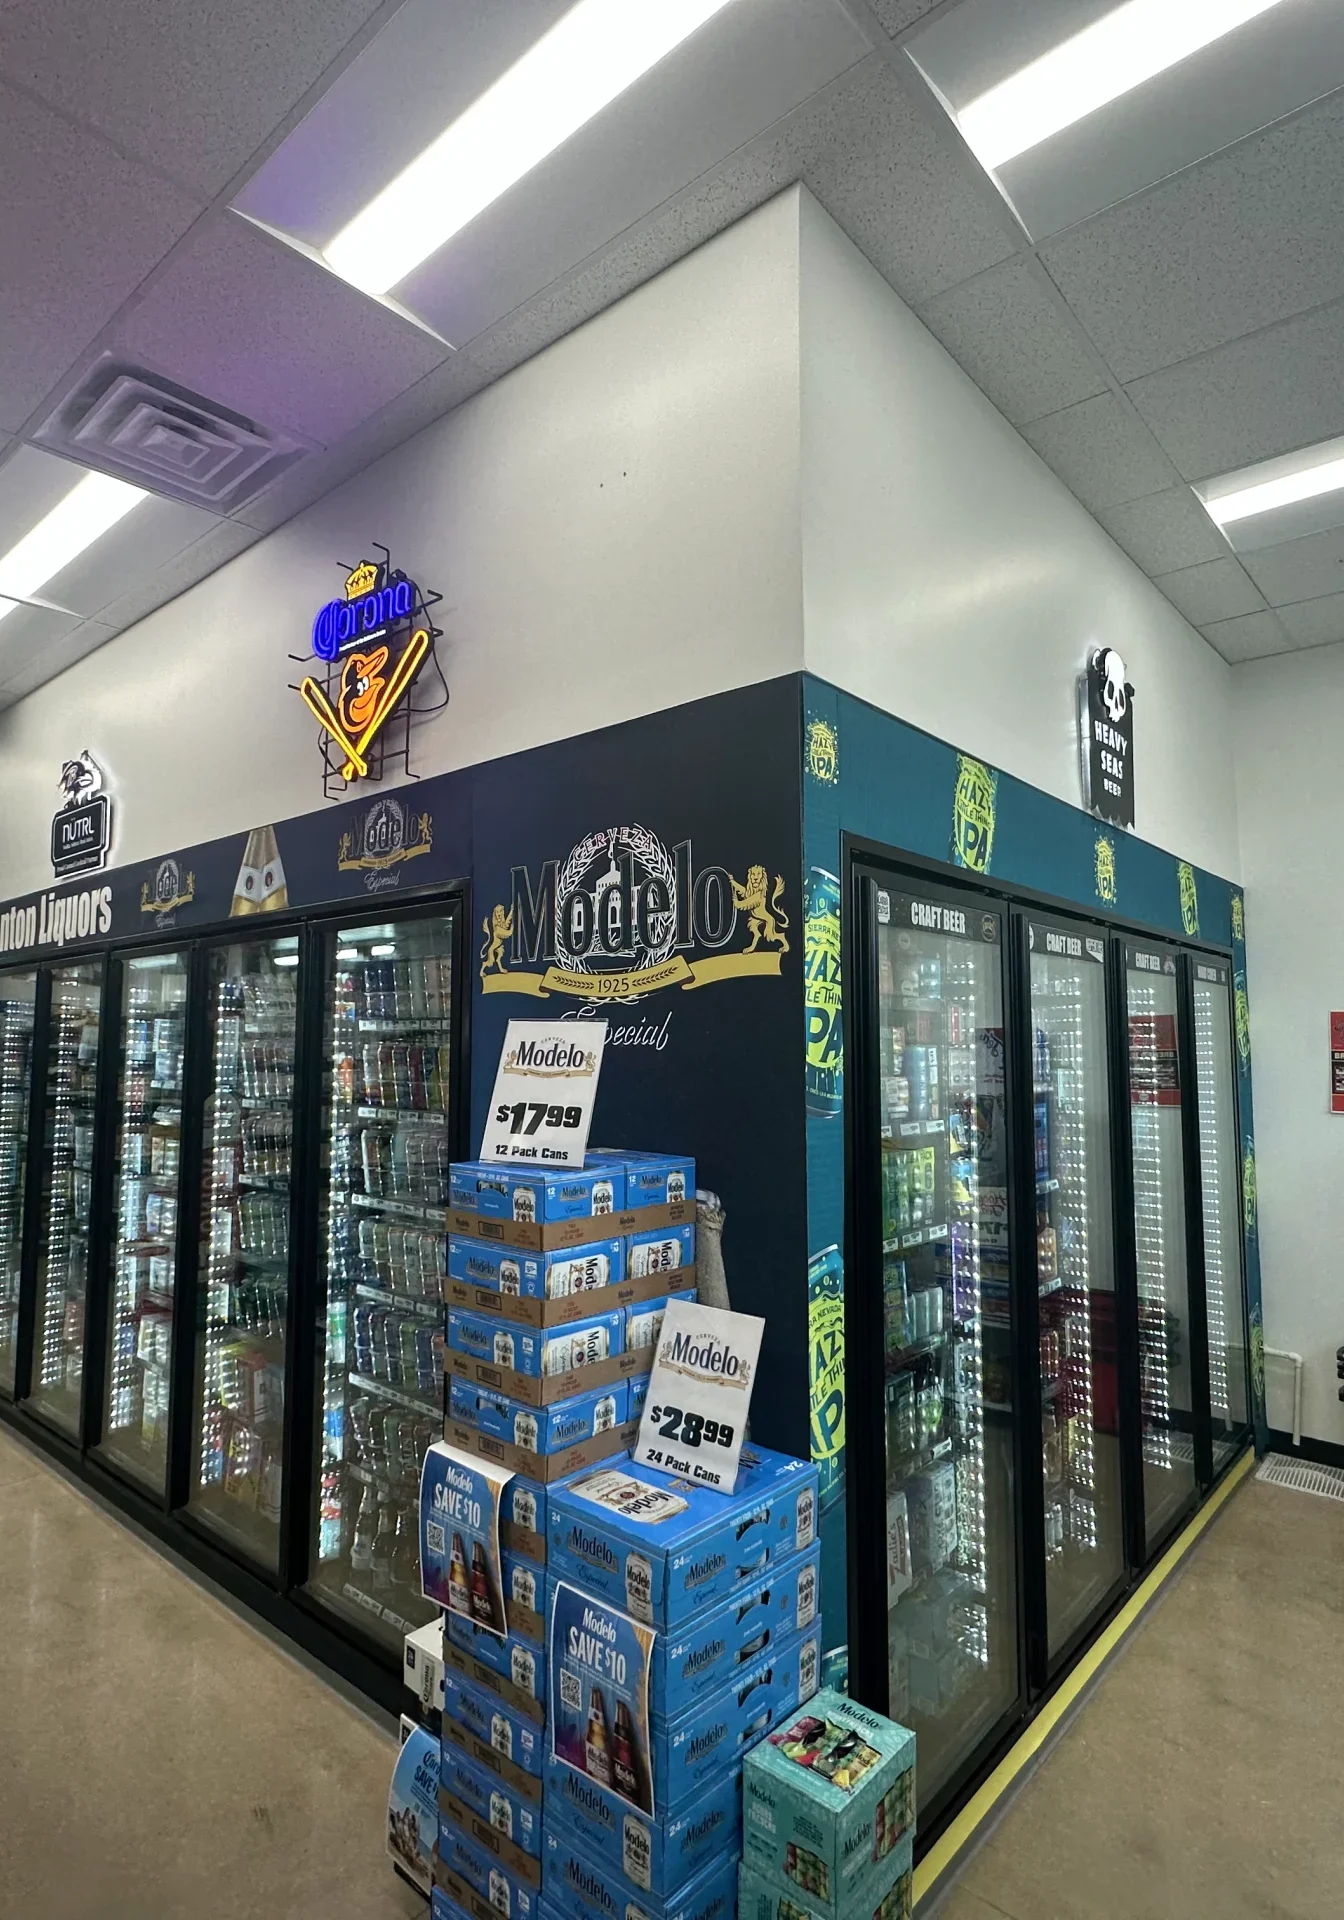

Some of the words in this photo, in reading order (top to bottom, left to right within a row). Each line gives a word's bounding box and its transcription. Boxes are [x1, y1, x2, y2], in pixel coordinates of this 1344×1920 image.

[312, 581, 411, 661] Corona
[1094, 720, 1128, 757] HEAVY
[1100, 750, 1123, 779] SEAS
[1103, 778, 1121, 798] BEER
[349, 804, 420, 857] Modelo
[957, 811, 989, 868] IPA
[573, 826, 653, 861] CERVEZA
[364, 869, 400, 892] Especial
[510, 838, 738, 964] Modelo
[38, 886, 112, 946] Liquors
[911, 902, 942, 930] CRAFT
[943, 909, 966, 934] BEER
[808, 924, 831, 935] SIERRA
[1046, 932, 1067, 955] CRAFT
[1067, 937, 1082, 956] BEER
[598, 977, 630, 993] 1925
[516, 1041, 585, 1068] Modelo
[495, 1144, 508, 1155] 12
[511, 1145, 538, 1158] Pack
[541, 1148, 568, 1160] Cans
[450, 1175, 456, 1184] 12
[629, 1175, 636, 1183] 12
[641, 1174, 662, 1186] Modelo
[547, 1186, 556, 1195] 12
[562, 1187, 586, 1198] Modelo
[593, 1190, 612, 1203] Modelo
[514, 1196, 535, 1213] Modelo
[613, 1240, 620, 1252] 12
[469, 1256, 494, 1275] Modelo
[449, 1315, 456, 1323] 12
[611, 1314, 620, 1326] 12
[817, 1304, 842, 1320] NEVADA
[461, 1325, 487, 1344] Modelo
[671, 1332, 739, 1376] Modelo
[451, 1386, 458, 1395] 12
[633, 1384, 641, 1393] 12
[551, 1414, 562, 1424] 12
[595, 1405, 613, 1421] Modelo
[516, 1418, 536, 1438] Modelo
[555, 1419, 585, 1439] Modelo
[646, 1449, 662, 1464] 24
[665, 1455, 691, 1475] Pack
[693, 1464, 721, 1484] Cans
[783, 1461, 804, 1472] 24
[445, 1465, 473, 1495] Modelo
[434, 1483, 462, 1520] SAVE
[463, 1499, 481, 1529] $10
[515, 1496, 535, 1517] Modelo
[618, 1490, 677, 1517] Modelo
[551, 1511, 561, 1523] 24
[572, 1525, 613, 1565] Modelo
[673, 1556, 684, 1570] 24
[689, 1553, 722, 1581] Modelo
[514, 1574, 535, 1594] Modelo
[575, 1563, 610, 1592] Especial
[626, 1563, 650, 1590] Modelo
[582, 1607, 617, 1643] Modelo
[569, 1626, 604, 1673] SAVE
[605, 1650, 627, 1685] $10
[671, 1644, 682, 1659] 24
[687, 1640, 722, 1668] Modelo
[513, 1653, 534, 1676] Modelo
[445, 1677, 453, 1688] 12
[460, 1691, 485, 1723] Modelo
[837, 1703, 879, 1728] Modelo
[492, 1721, 510, 1744] Modelo
[673, 1732, 685, 1747] 24
[690, 1723, 724, 1756] Modelo
[443, 1751, 451, 1762] 12
[414, 1764, 434, 1794] SAVE
[567, 1771, 609, 1821] Modelo
[749, 1782, 776, 1808] Modelo
[491, 1799, 510, 1821] Modelo
[441, 1825, 449, 1837] 12
[669, 1823, 681, 1837] 24
[685, 1810, 719, 1843] Modelo
[548, 1835, 557, 1849] 24
[624, 1823, 650, 1855] Modelo
[844, 1823, 871, 1857] Modelo
[569, 1856, 612, 1910] Modelo
[434, 1905, 441, 1916] 12
